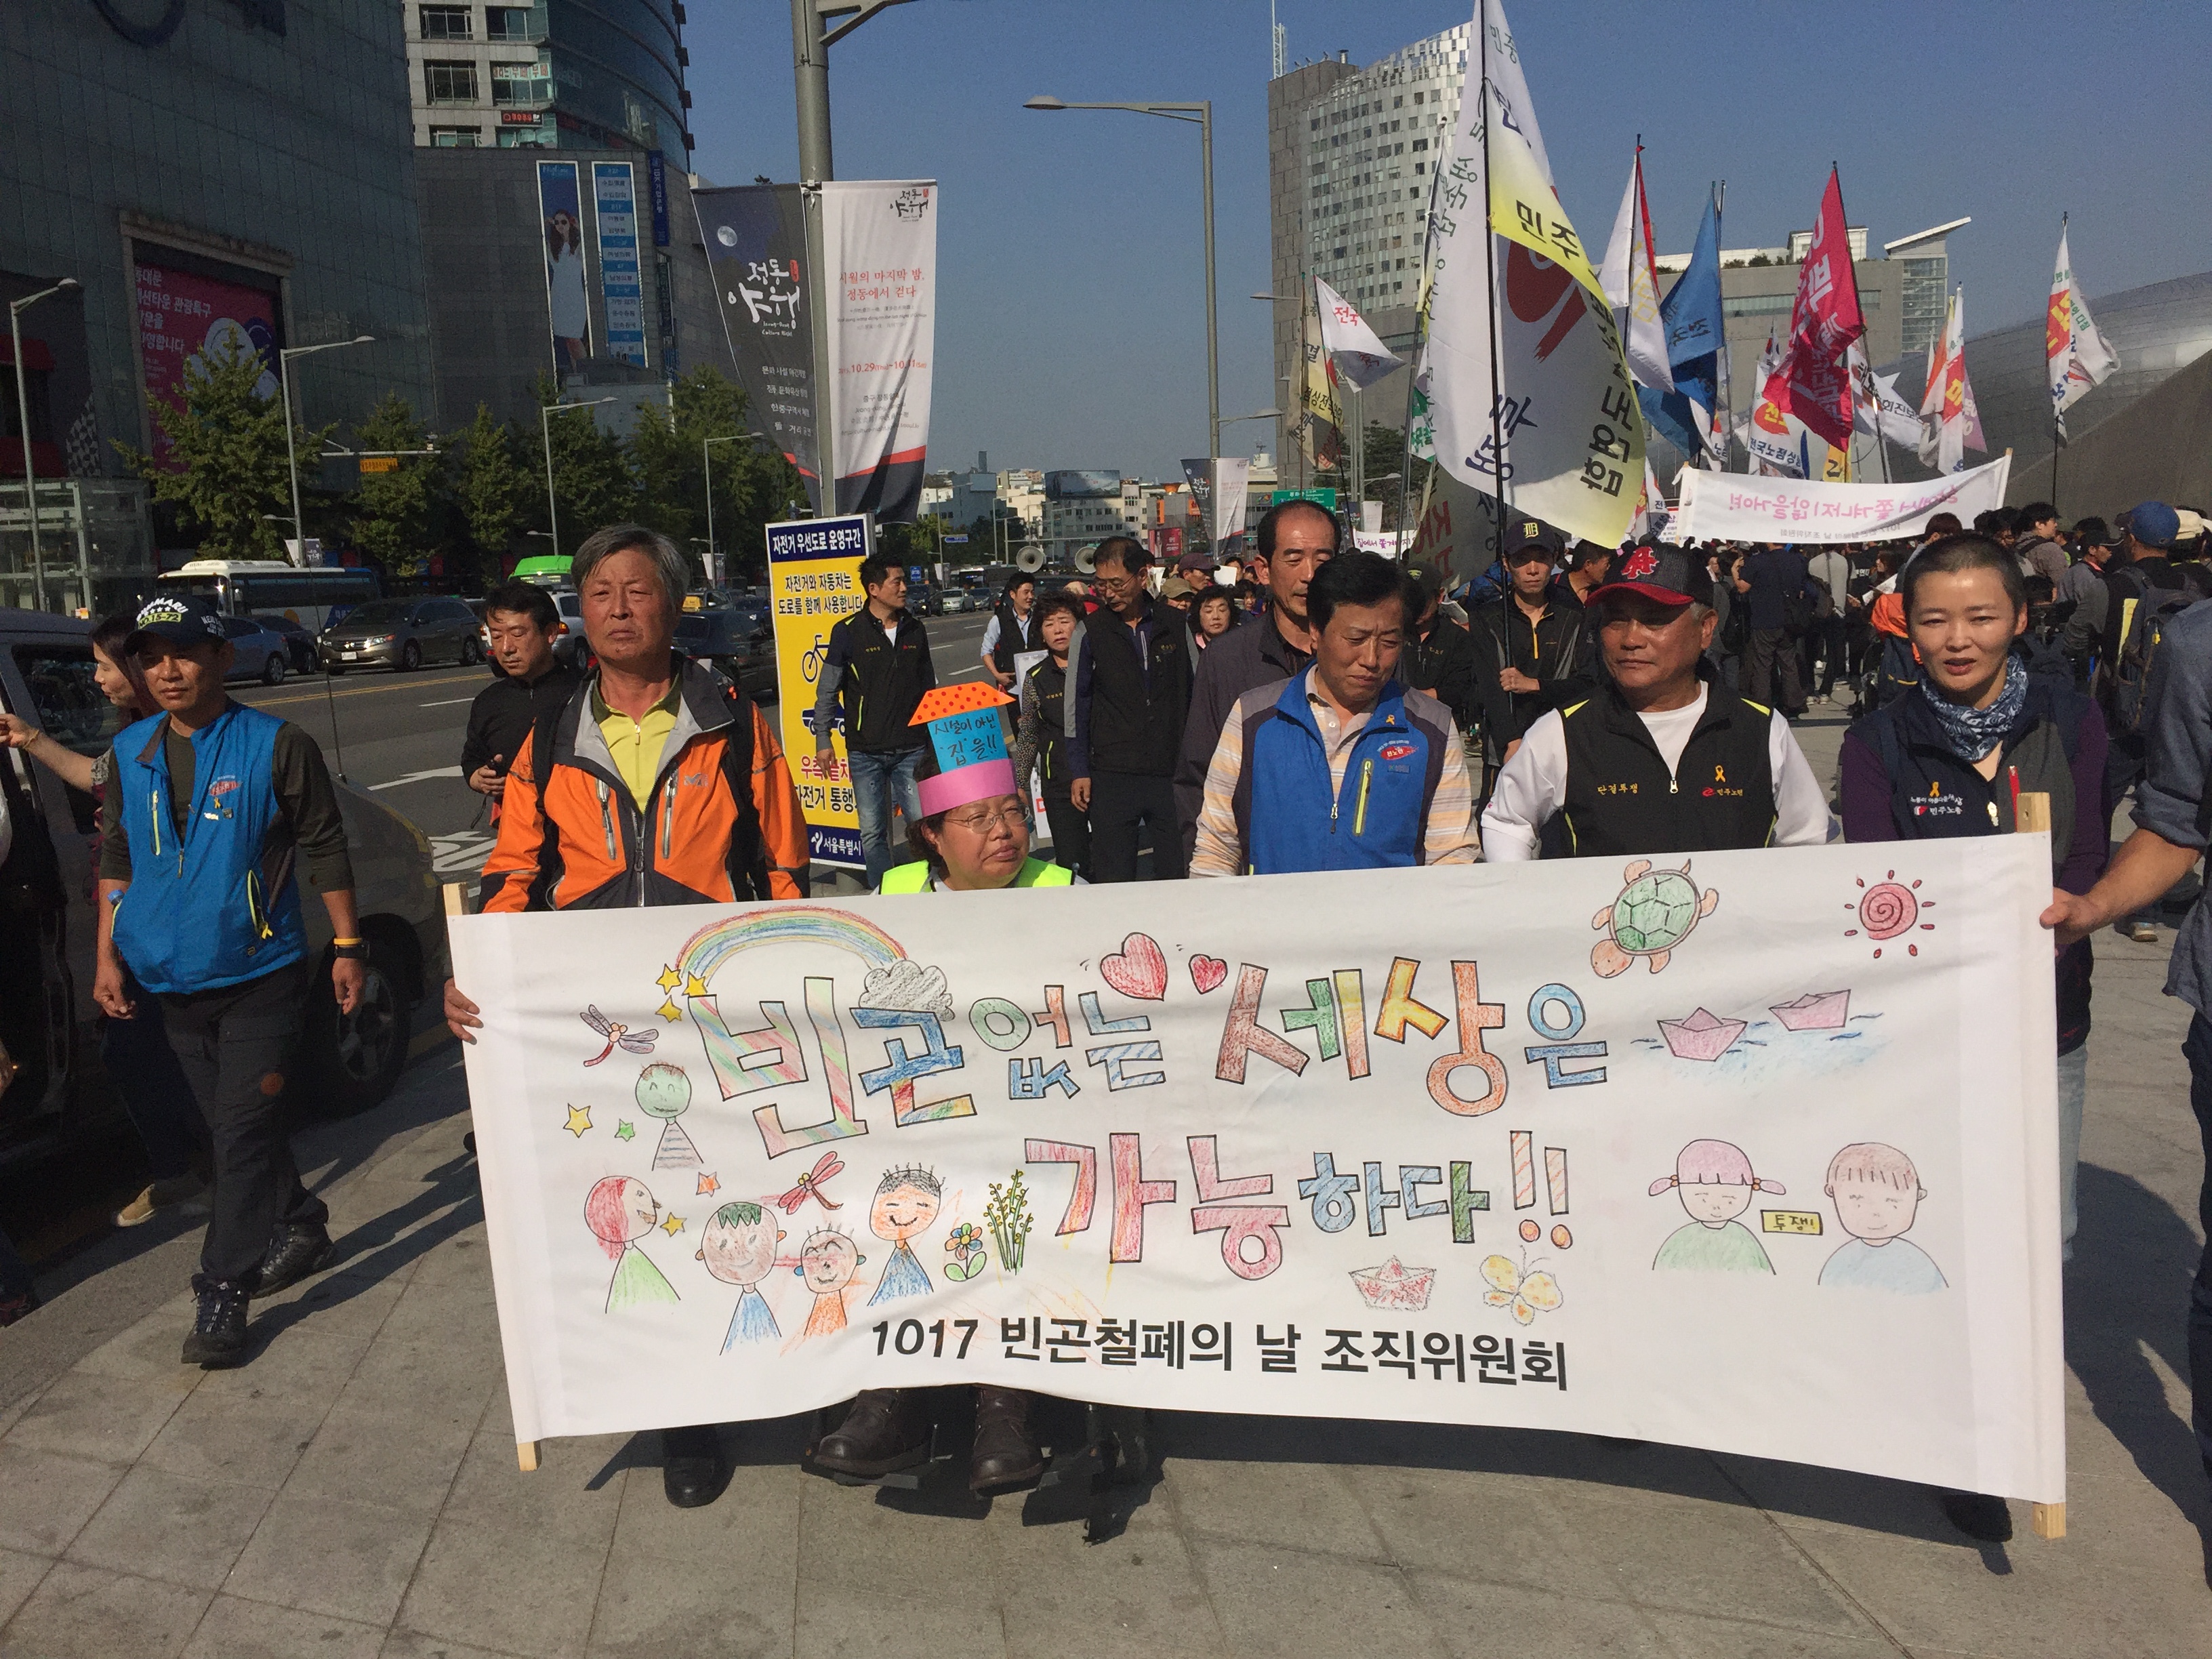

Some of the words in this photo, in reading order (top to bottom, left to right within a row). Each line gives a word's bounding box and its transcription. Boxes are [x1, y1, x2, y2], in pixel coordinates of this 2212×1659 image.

[747, 259, 790, 285] 정동
[840, 271, 869, 285] 시월의
[874, 268, 908, 283] 마지막
[847, 287, 890, 301] 정동에서
[895, 285, 917, 298] 걷다
[773, 533, 796, 554] 자전거
[797, 532, 827, 553] 우선도로
[829, 527, 861, 550] 운영구간
[785, 574, 817, 593] 자전거와
[819, 572, 852, 592] 자동차는
[779, 597, 803, 615] 도로를
[805, 596, 821, 615] 함께
[823, 594, 863, 614] 사용합니다
[935, 720, 972, 735] 시설이
[975, 714, 997, 730] 아닌
[823, 836, 861, 857] 서울특별시
[687, 976, 977, 1160] 빈곤
[969, 984, 1167, 1100] 없는
[1215, 956, 1608, 1118] 세상은
[1025, 1130, 1573, 1280] 가능하다!!
[872, 1317, 979, 1360] 1017
[1000, 1315, 1232, 1372] 빈곤철폐의
[1256, 1324, 1302, 1374] 날
[1321, 1328, 1568, 1391] 조직위원회
